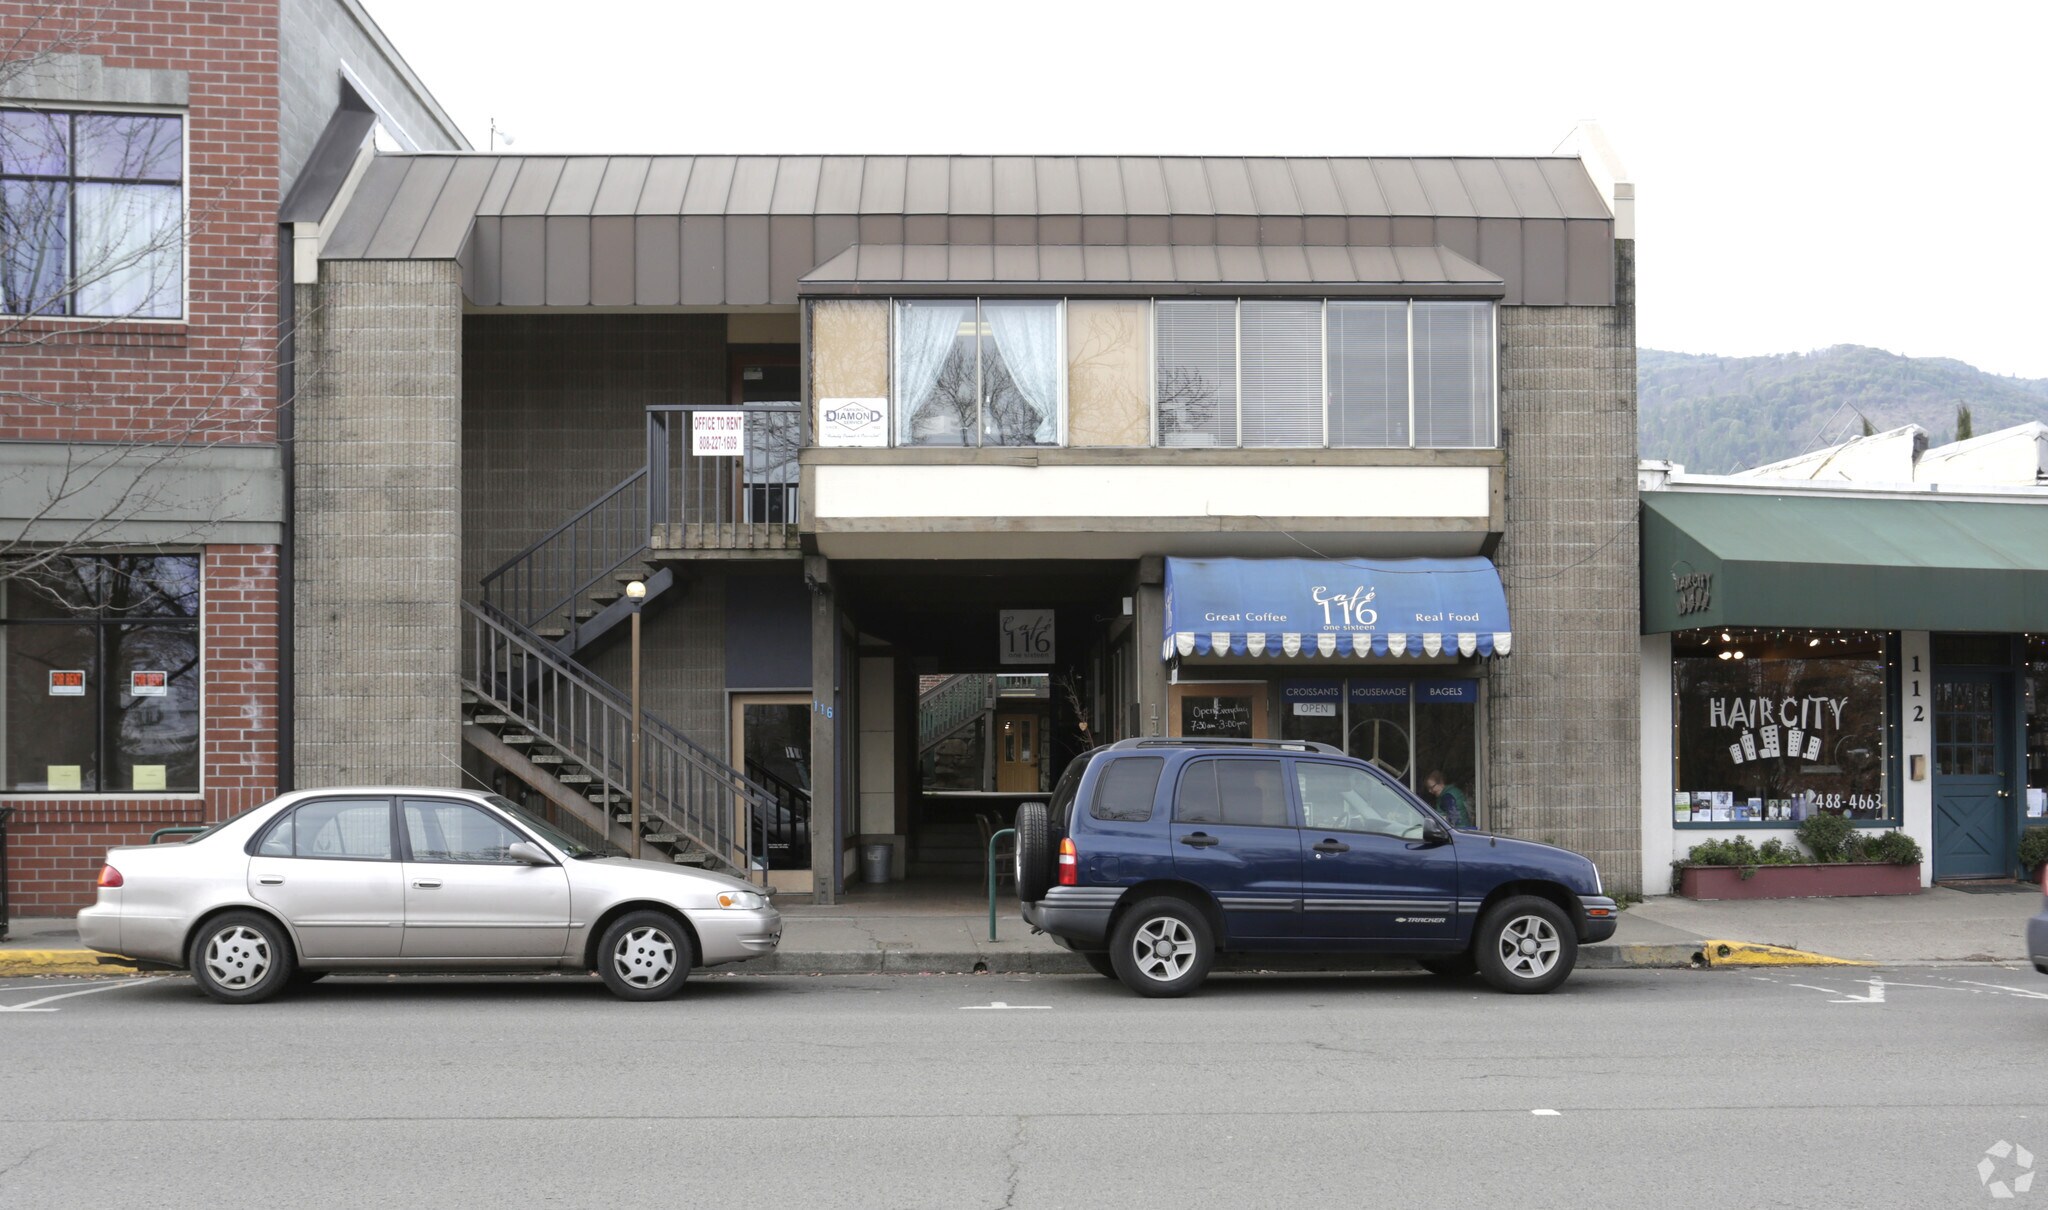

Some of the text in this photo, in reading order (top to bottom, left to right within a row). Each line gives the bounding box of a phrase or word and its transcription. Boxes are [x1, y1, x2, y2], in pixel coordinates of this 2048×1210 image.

[826, 410, 881, 422] DIAMOND
[694, 416, 742, 430] OFFICE TO RENT
[1312, 585, 1376, 611] Café
[1205, 612, 1288, 622] Great Coffee
[1318, 600, 1378, 625] 116
[1415, 612, 1480, 622] Real Food
[1002, 615, 1052, 640] Café
[1343, 624, 1376, 632] sixteen
[1006, 630, 1051, 653] 116
[1286, 687, 1339, 697] CROISSANTS
[1352, 687, 1407, 697] HOUSEMADE
[1430, 687, 1462, 696] BAGELS
[814, 700, 833, 719] 116
[1301, 703, 1329, 713] OPEN
[1815, 793, 1882, 809] 488-4663
